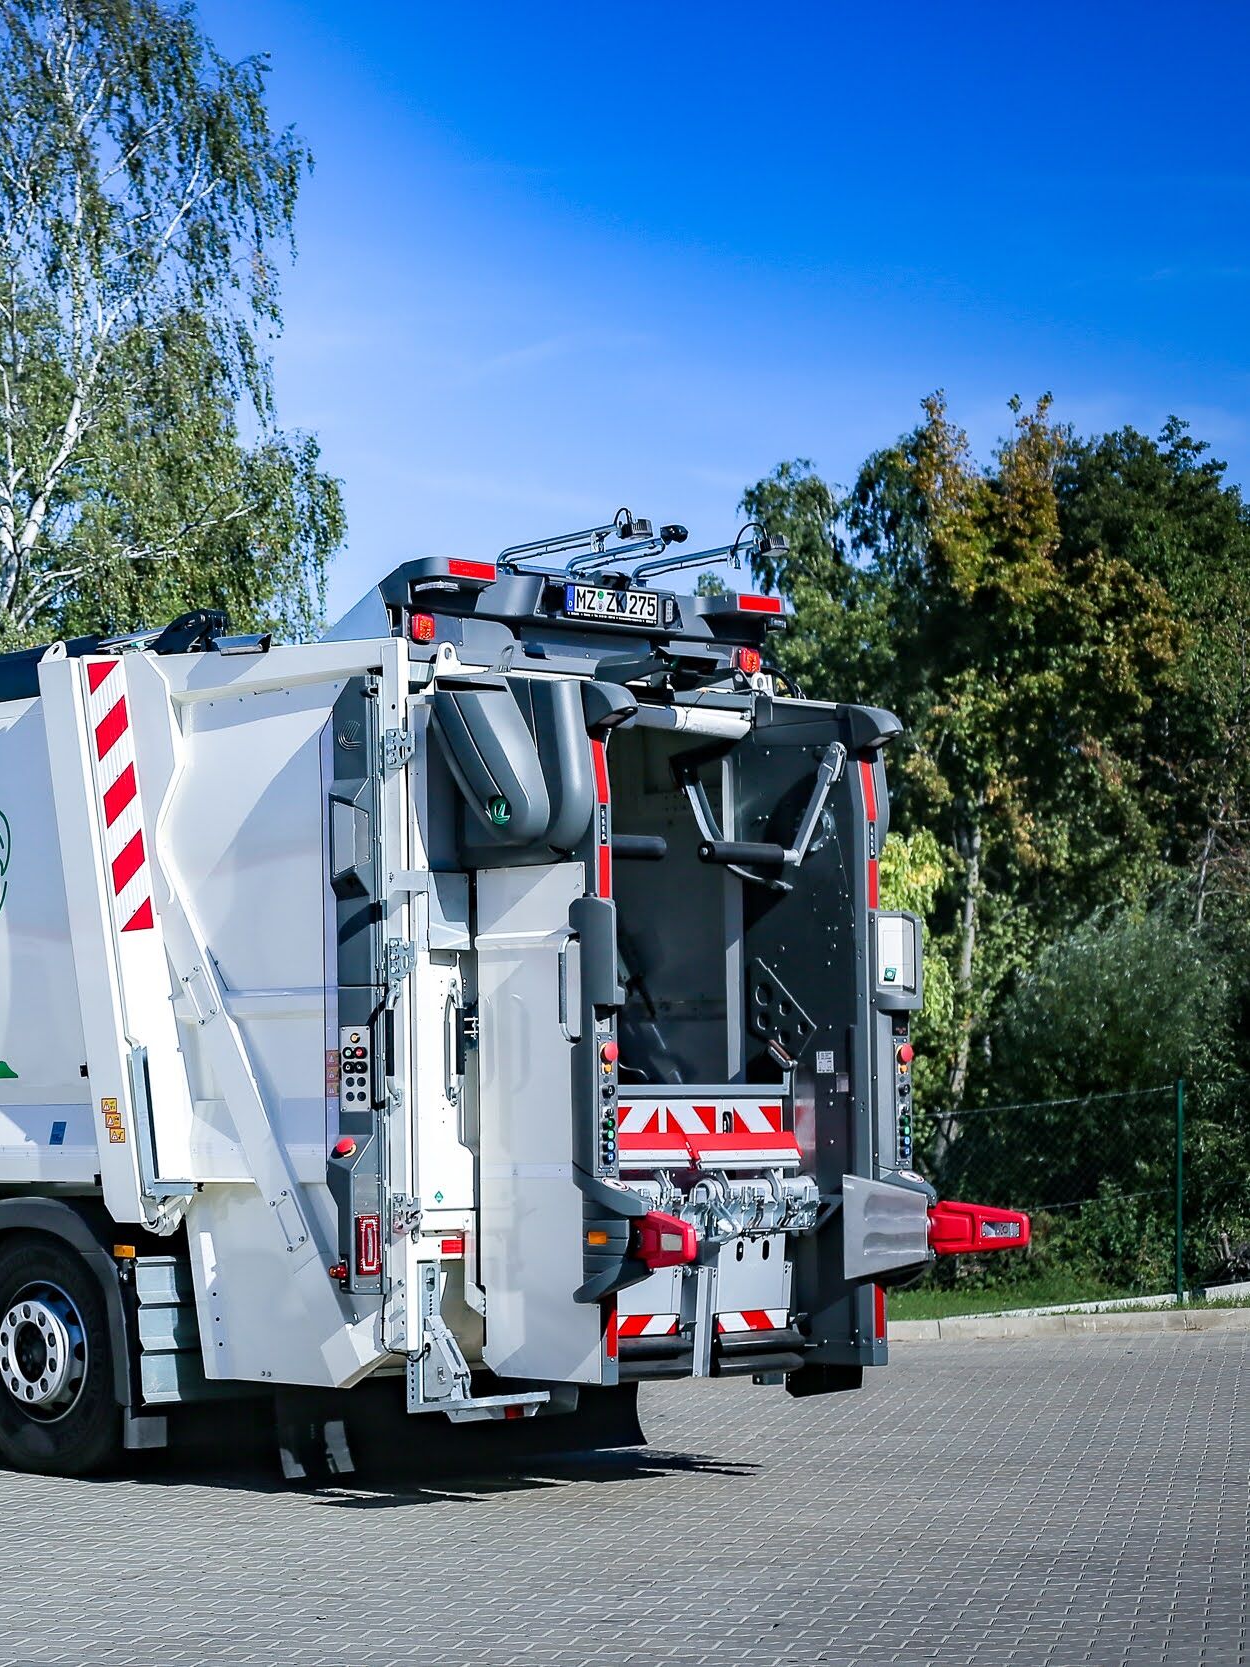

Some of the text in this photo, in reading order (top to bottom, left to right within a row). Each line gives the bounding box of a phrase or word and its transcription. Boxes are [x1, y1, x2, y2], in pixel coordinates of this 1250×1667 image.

[576, 588, 656, 617] MZ ZK 275
